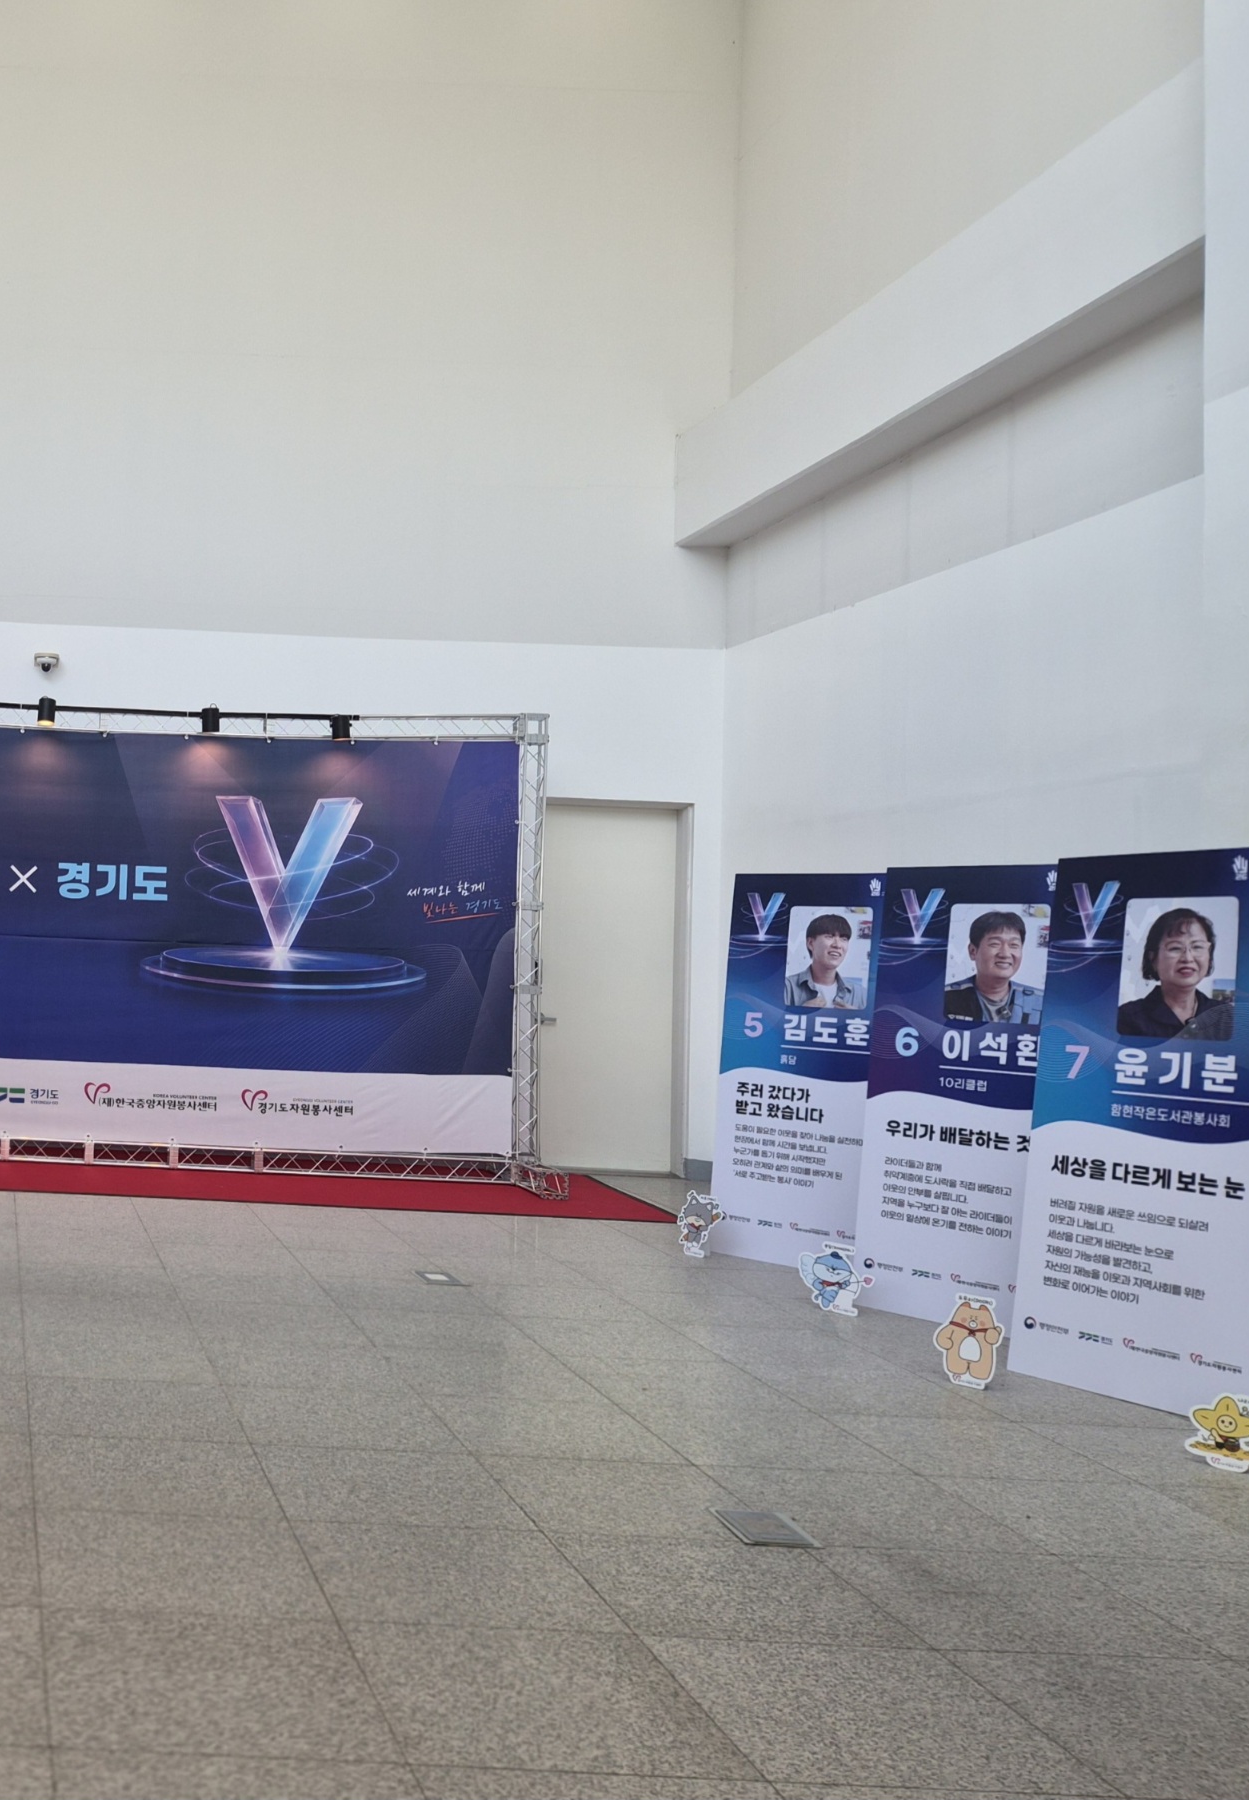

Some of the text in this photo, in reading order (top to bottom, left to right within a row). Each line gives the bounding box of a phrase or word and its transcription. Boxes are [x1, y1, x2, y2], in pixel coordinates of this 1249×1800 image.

[57, 862, 168, 901] 경기도
[407, 881, 485, 896] 세계와 함께
[423, 899, 503, 918] 빛나는 경기도
[744, 1012, 870, 1046] 5 김도훈
[895, 1027, 1040, 1067] 6 이석환
[1065, 1045, 1238, 1093] 7 윤기분
[30, 1089, 59, 1099] 경기도
[737, 1082, 810, 1103] 주러 갔다가
[939, 1076, 987, 1092] 10리클럽
[99, 1097, 217, 1112] (재)한국중앙자원봉사센터
[258, 1102, 353, 1116] 경기도자원봉사센터
[736, 1100, 824, 1124] 받고 왔습니다
[1111, 1103, 1230, 1128] 함현작은도서관봉사회
[735, 1124, 755, 1133] 도움이
[757, 1126, 776, 1136] 필요한
[778, 1129, 797, 1138] 이웃을
[886, 1120, 935, 1141] 우리가
[940, 1127, 1010, 1151] 배달하는
[734, 1147, 760, 1157] 누군가를
[792, 1155, 826, 1166] 시작했지만
[885, 1157, 942, 1172] 라이더들과 함께
[749, 1171, 776, 1182] 주고받는
[793, 1178, 814, 1188] 이야기
[884, 1170, 1012, 1196] 취약계층에 도시락을 직접 배달하고
[1051, 1155, 1245, 1200] 세상을 다르게 보는 눈
[883, 1183, 968, 1204] 이웃의 안부를 살핍니다.
[882, 1196, 1012, 1225] 지역을 누구보다 잘 아는 라이더들이
[1050, 1199, 1209, 1232] 버려질 자원을 새로운 쓰임으로 되살려
[881, 1210, 1011, 1239] 이웃의 일상에 온기를 전하는 이야기
[1049, 1214, 1115, 1233] 이웃과 나눕니다.
[1046, 1245, 1072, 1258] 자원의
[1075, 1250, 1111, 1265] 가능성을
[1047, 1229, 1174, 1260] 세상을 다르게 바라보는 눈으로
[1043, 1276, 1139, 1304] 변화로 이어가는 이야기
[1045, 1260, 1205, 1300] 자신의 재능을 이웃과 지역사회를 위한
